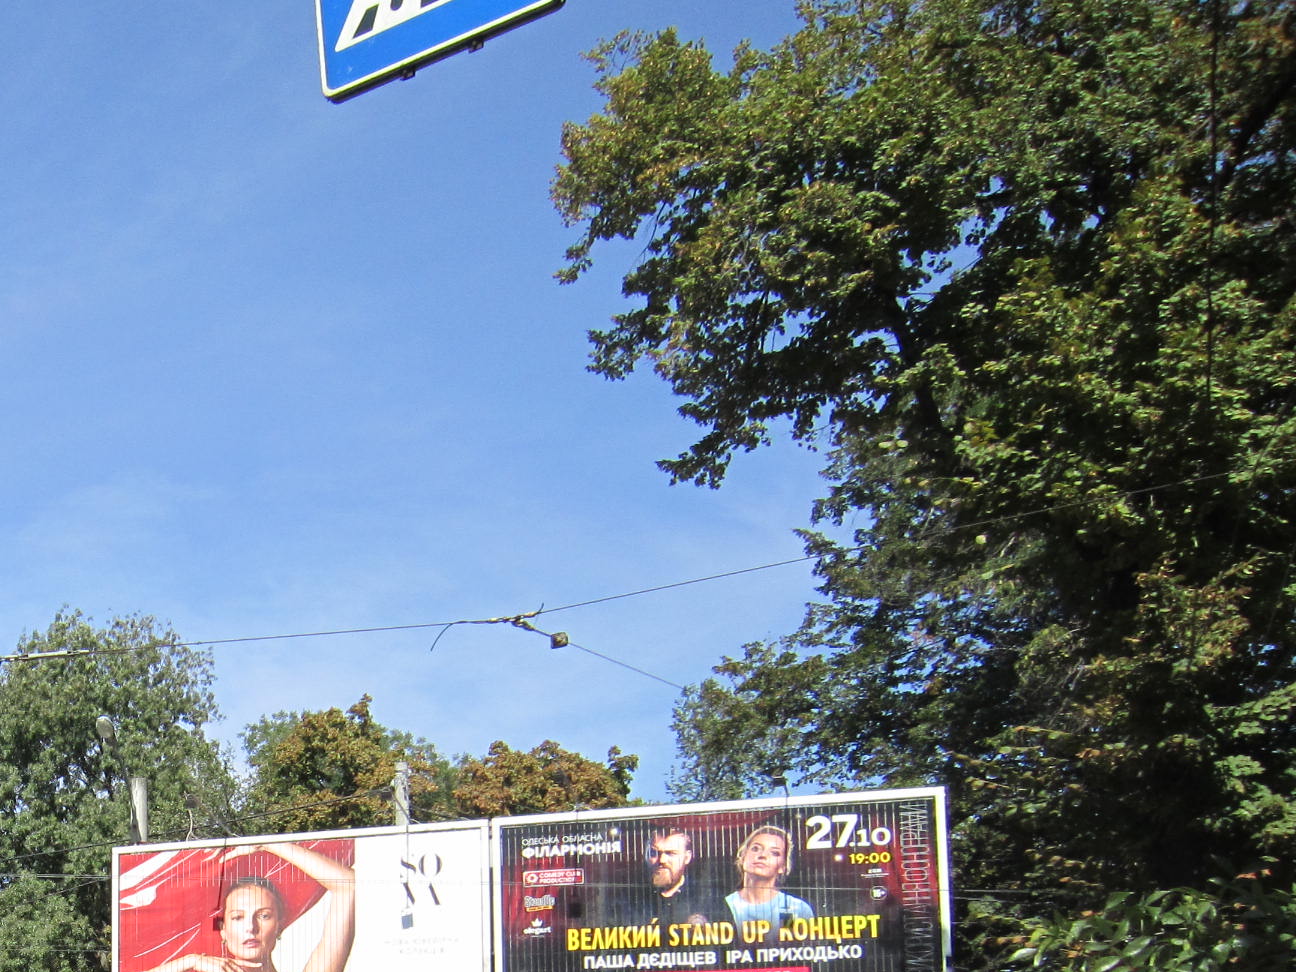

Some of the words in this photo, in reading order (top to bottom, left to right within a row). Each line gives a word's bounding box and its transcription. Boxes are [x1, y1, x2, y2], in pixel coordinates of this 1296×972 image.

[805, 814, 891, 849] 27.10
[521, 841, 621, 858] ФІЛАРМОНІЯ
[849, 852, 891, 864] 19:00
[567, 918, 661, 951] ВЕЛИКИЙ
[668, 922, 734, 947] STAND
[742, 920, 770, 944] UP
[779, 914, 881, 943] КОНЦЕРТ
[583, 954, 635, 969] ПАША
[636, 951, 716, 970] ДЄДІЩЕВ
[726, 949, 753, 964] ІРА
[757, 944, 862, 963] ПРИХОДЬКО
